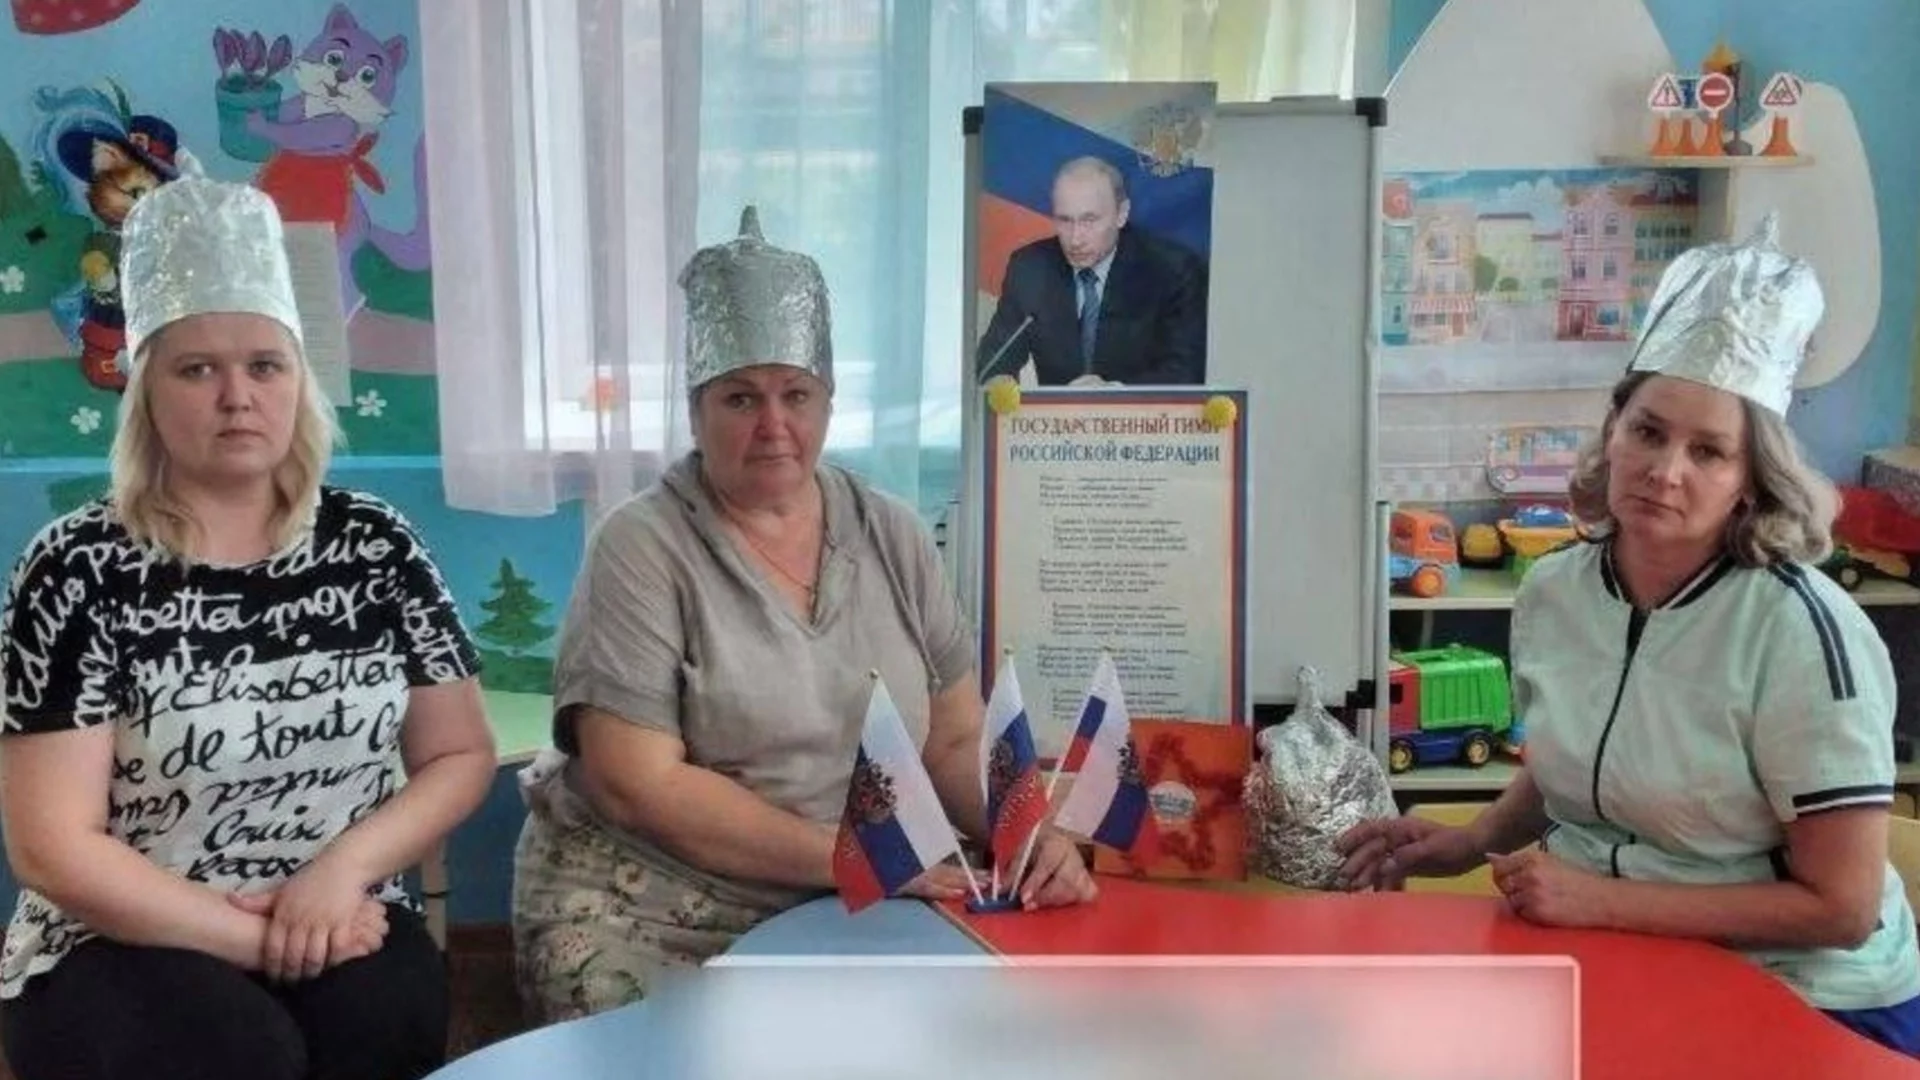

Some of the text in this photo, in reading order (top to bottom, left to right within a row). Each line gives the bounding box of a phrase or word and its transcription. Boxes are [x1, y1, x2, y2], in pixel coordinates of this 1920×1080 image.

[1010, 413, 1168, 436] ГОСУДАРСТВЕННЫЙ
[1009, 440, 1220, 466] РОССИЙСКОЙ ФЕДЕРАЦИИ
[160, 722, 225, 779] de
[238, 698, 366, 763] tout
